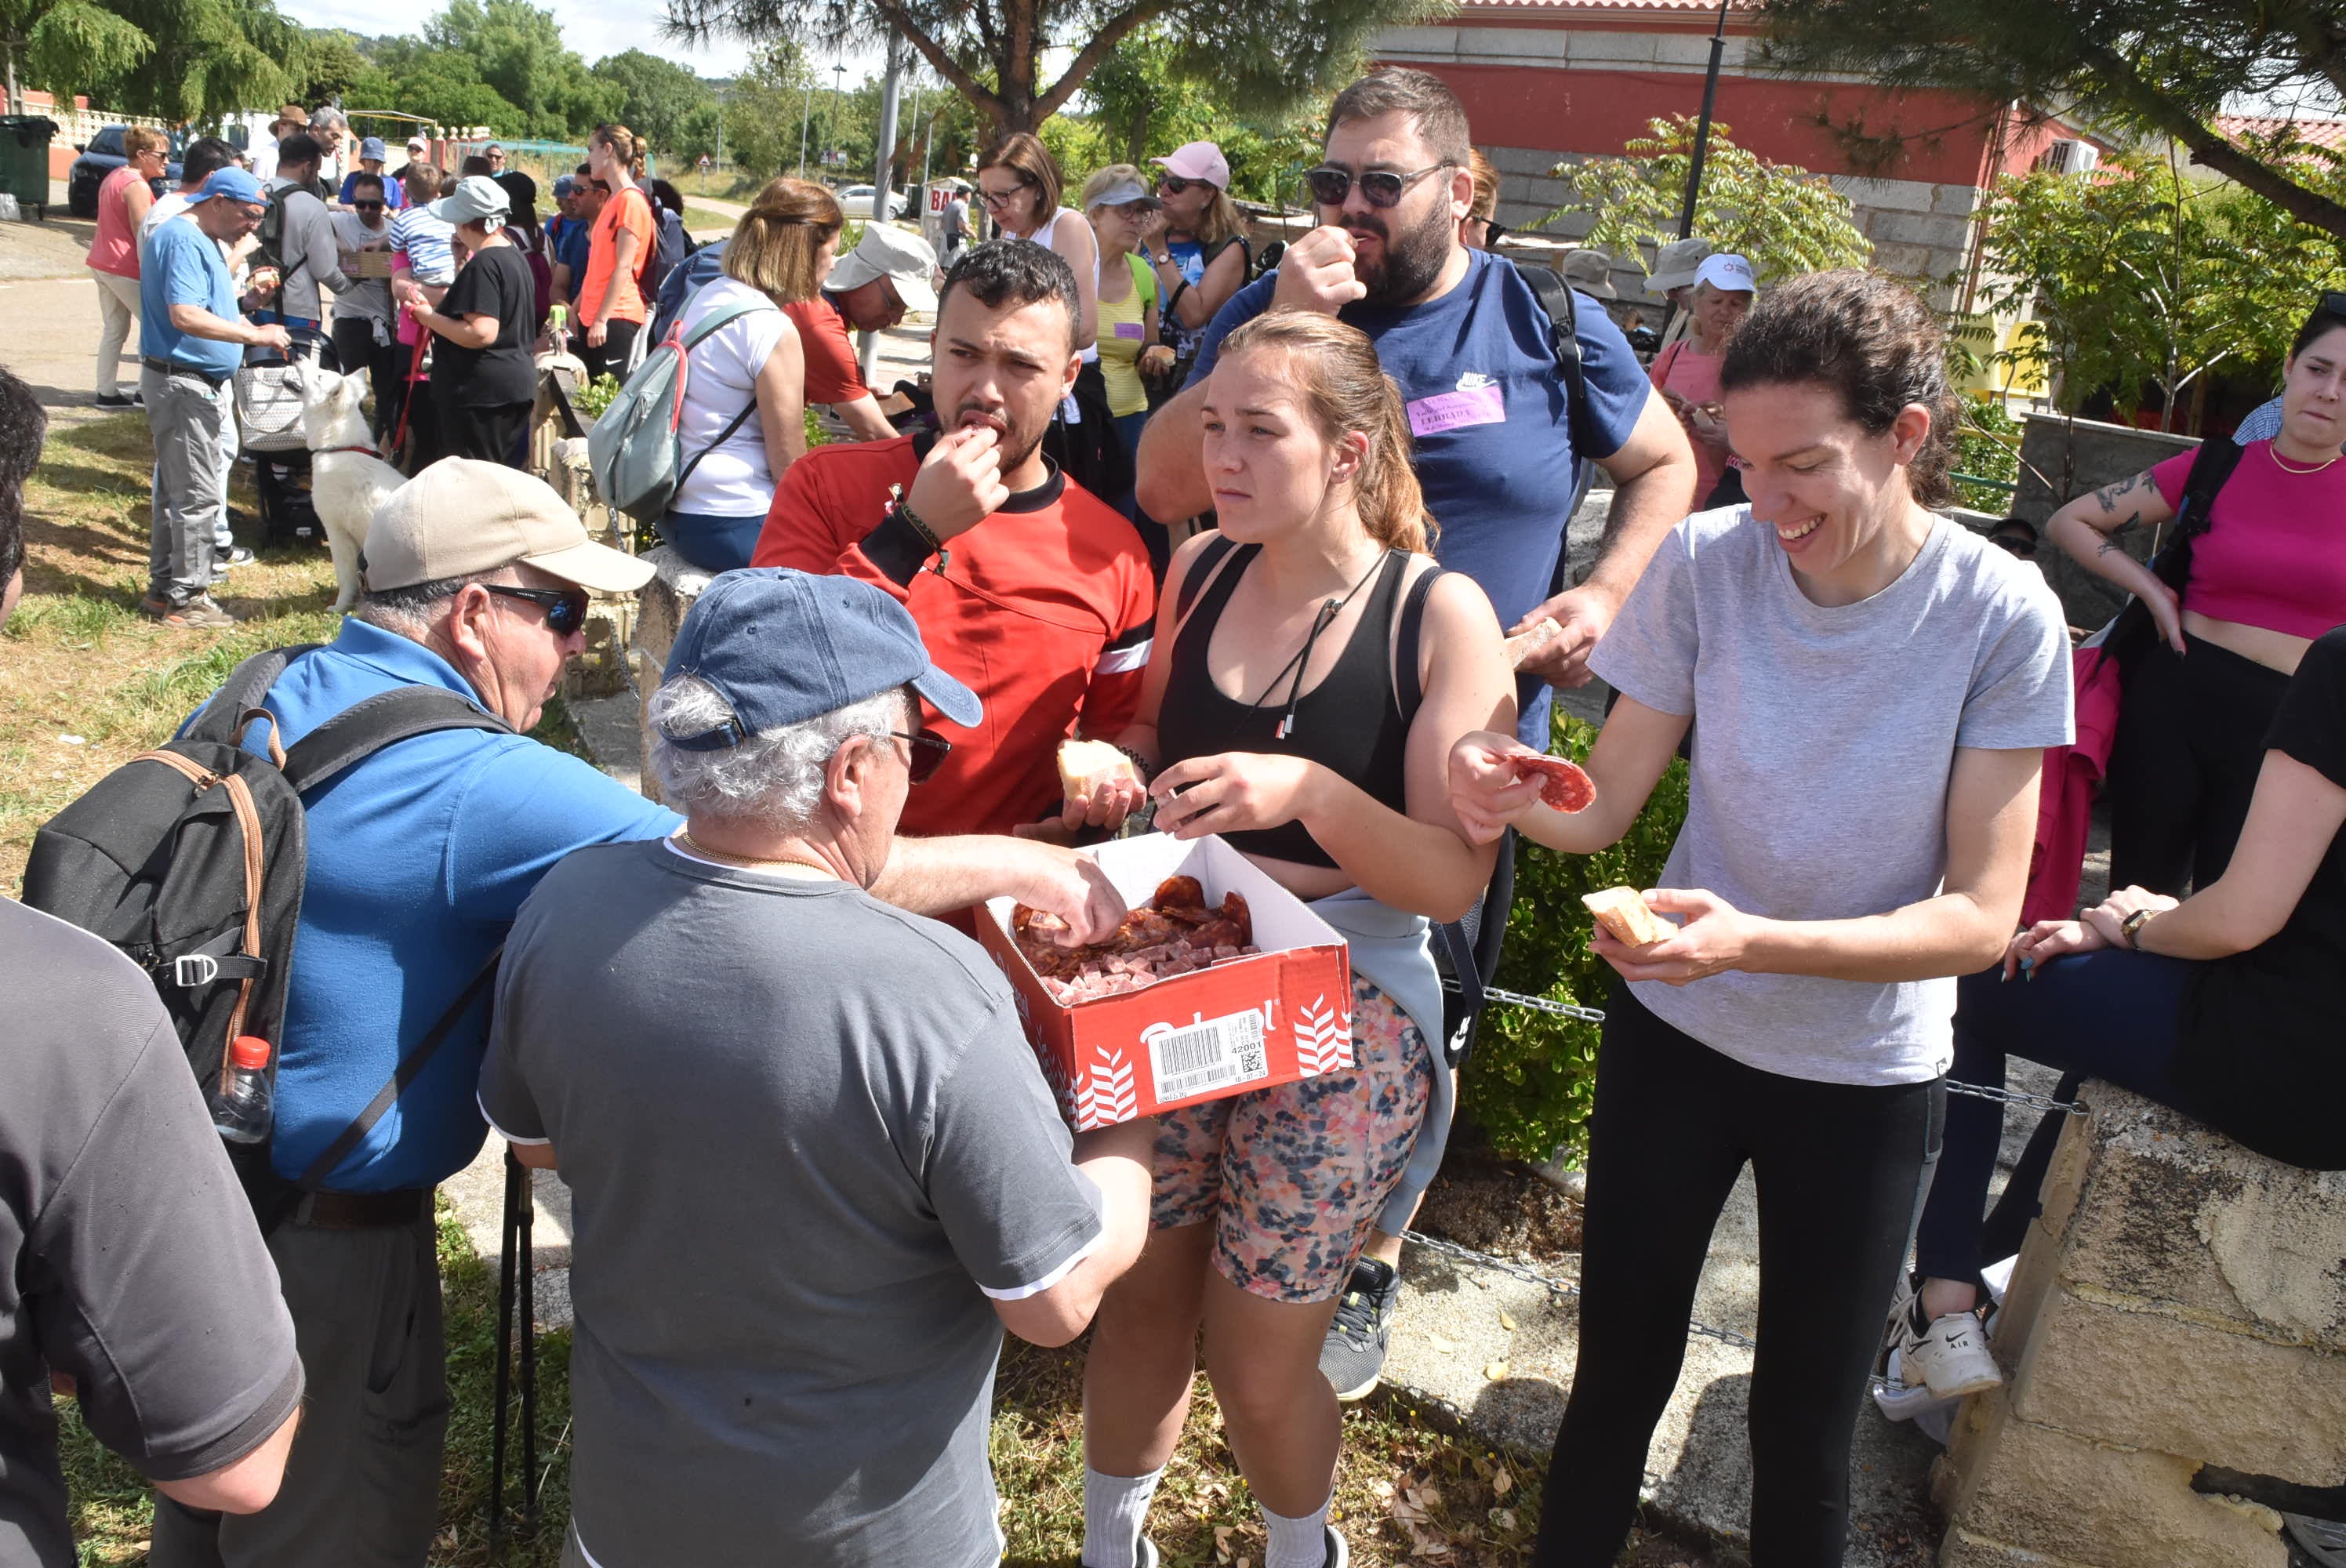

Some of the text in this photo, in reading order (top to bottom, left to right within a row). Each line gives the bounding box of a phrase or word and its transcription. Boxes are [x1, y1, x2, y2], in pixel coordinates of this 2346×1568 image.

[1461, 372, 1487, 386] NIKE
[1231, 1040, 1262, 1054] 42001
[1950, 1341, 1969, 1349] AIR
